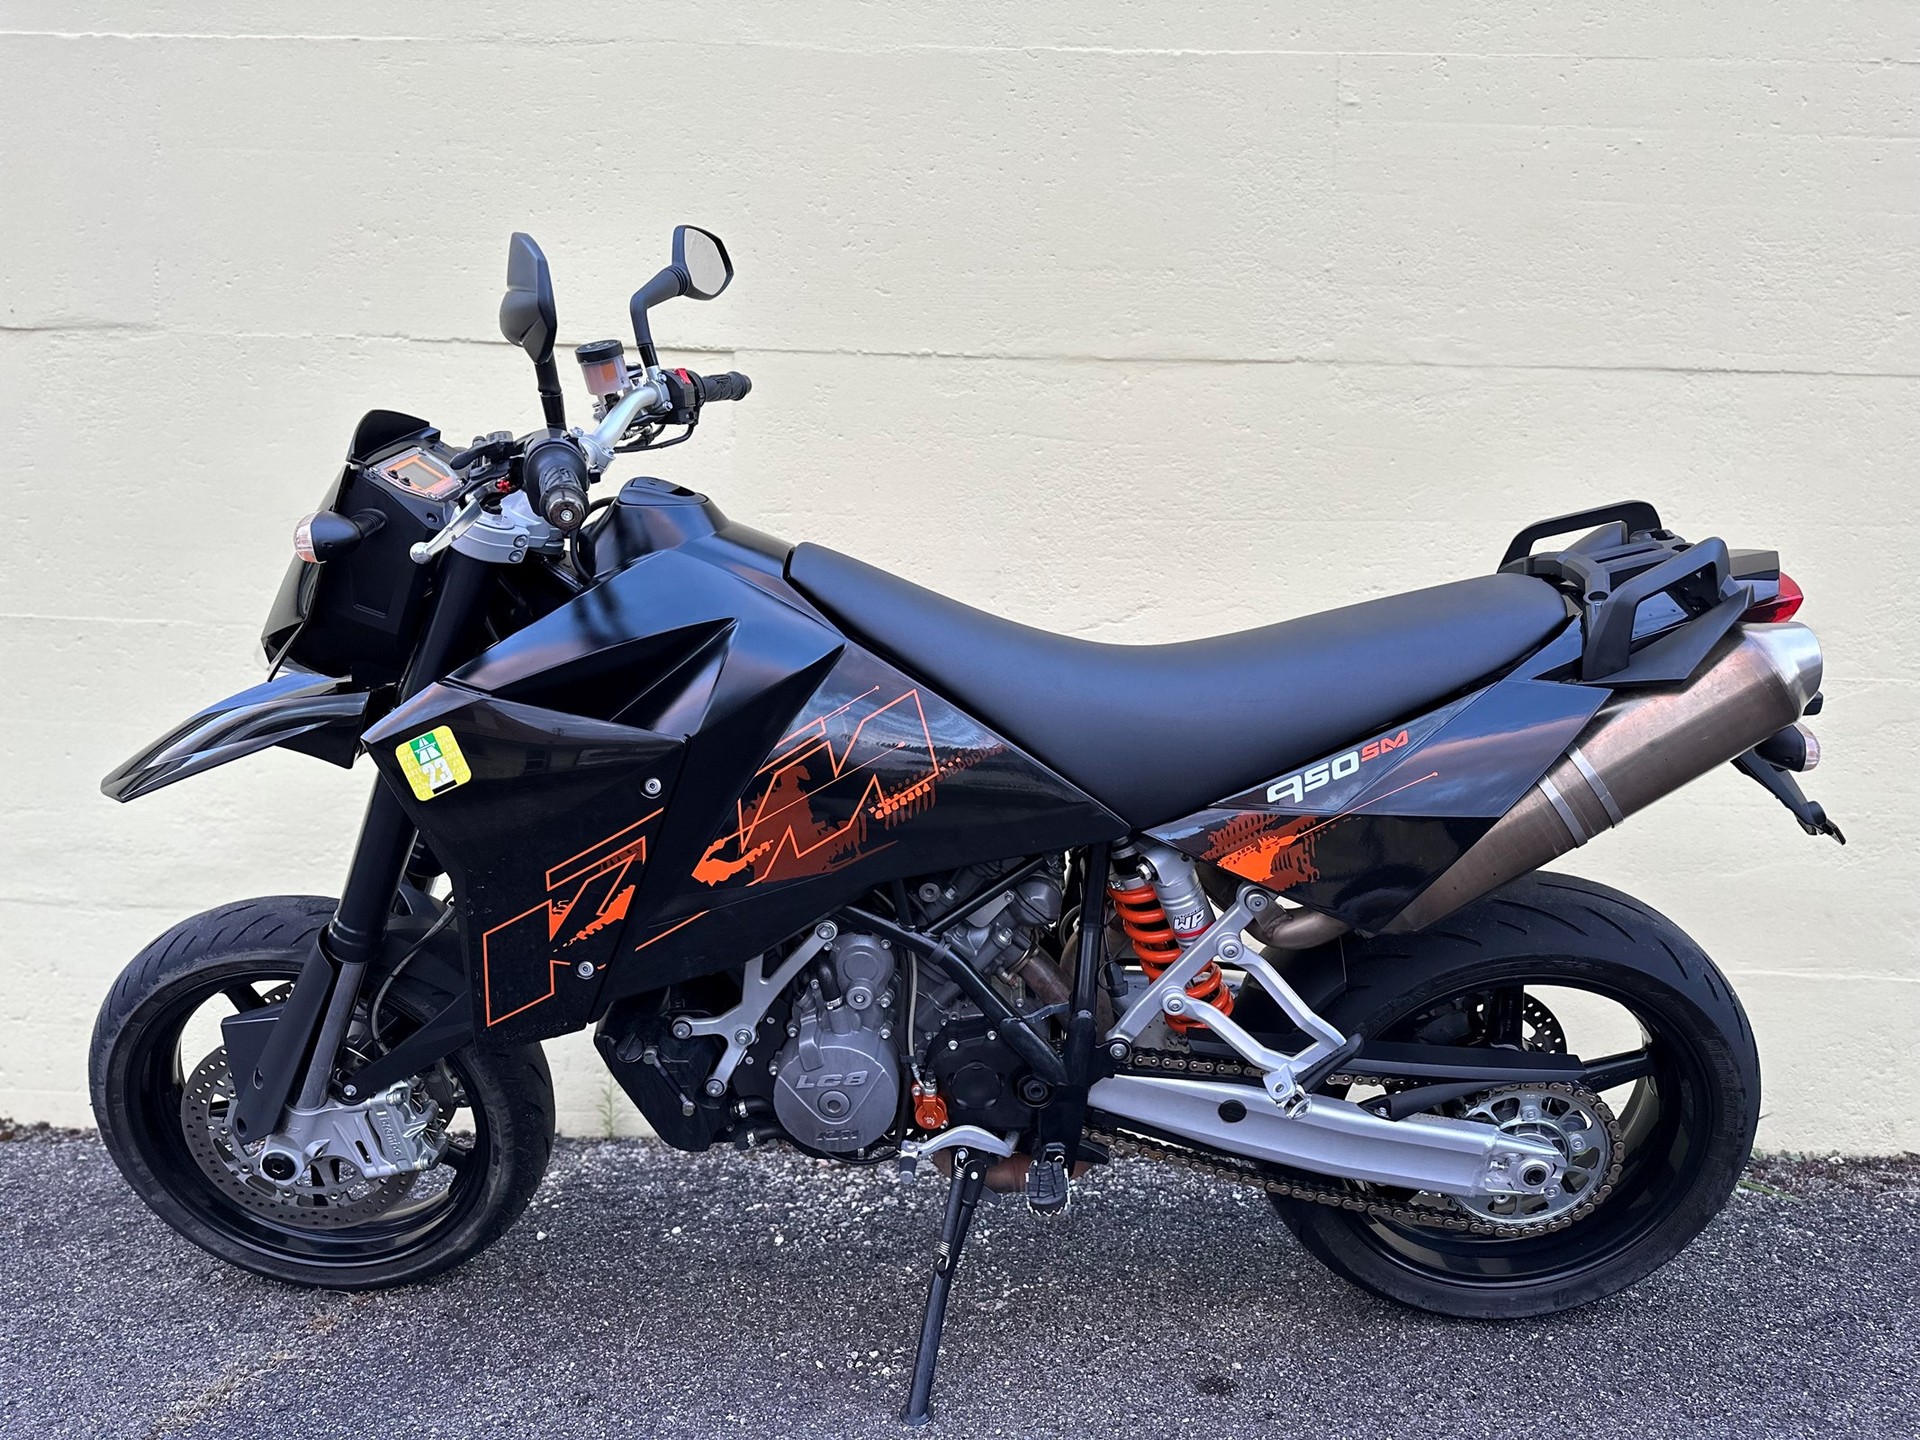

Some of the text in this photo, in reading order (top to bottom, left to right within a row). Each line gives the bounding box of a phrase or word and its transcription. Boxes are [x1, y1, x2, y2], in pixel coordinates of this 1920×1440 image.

[420, 757, 455, 791] 23
[1266, 750, 1360, 804] 950
[1173, 909, 1205, 931] WP
[795, 1070, 869, 1089] LC8
